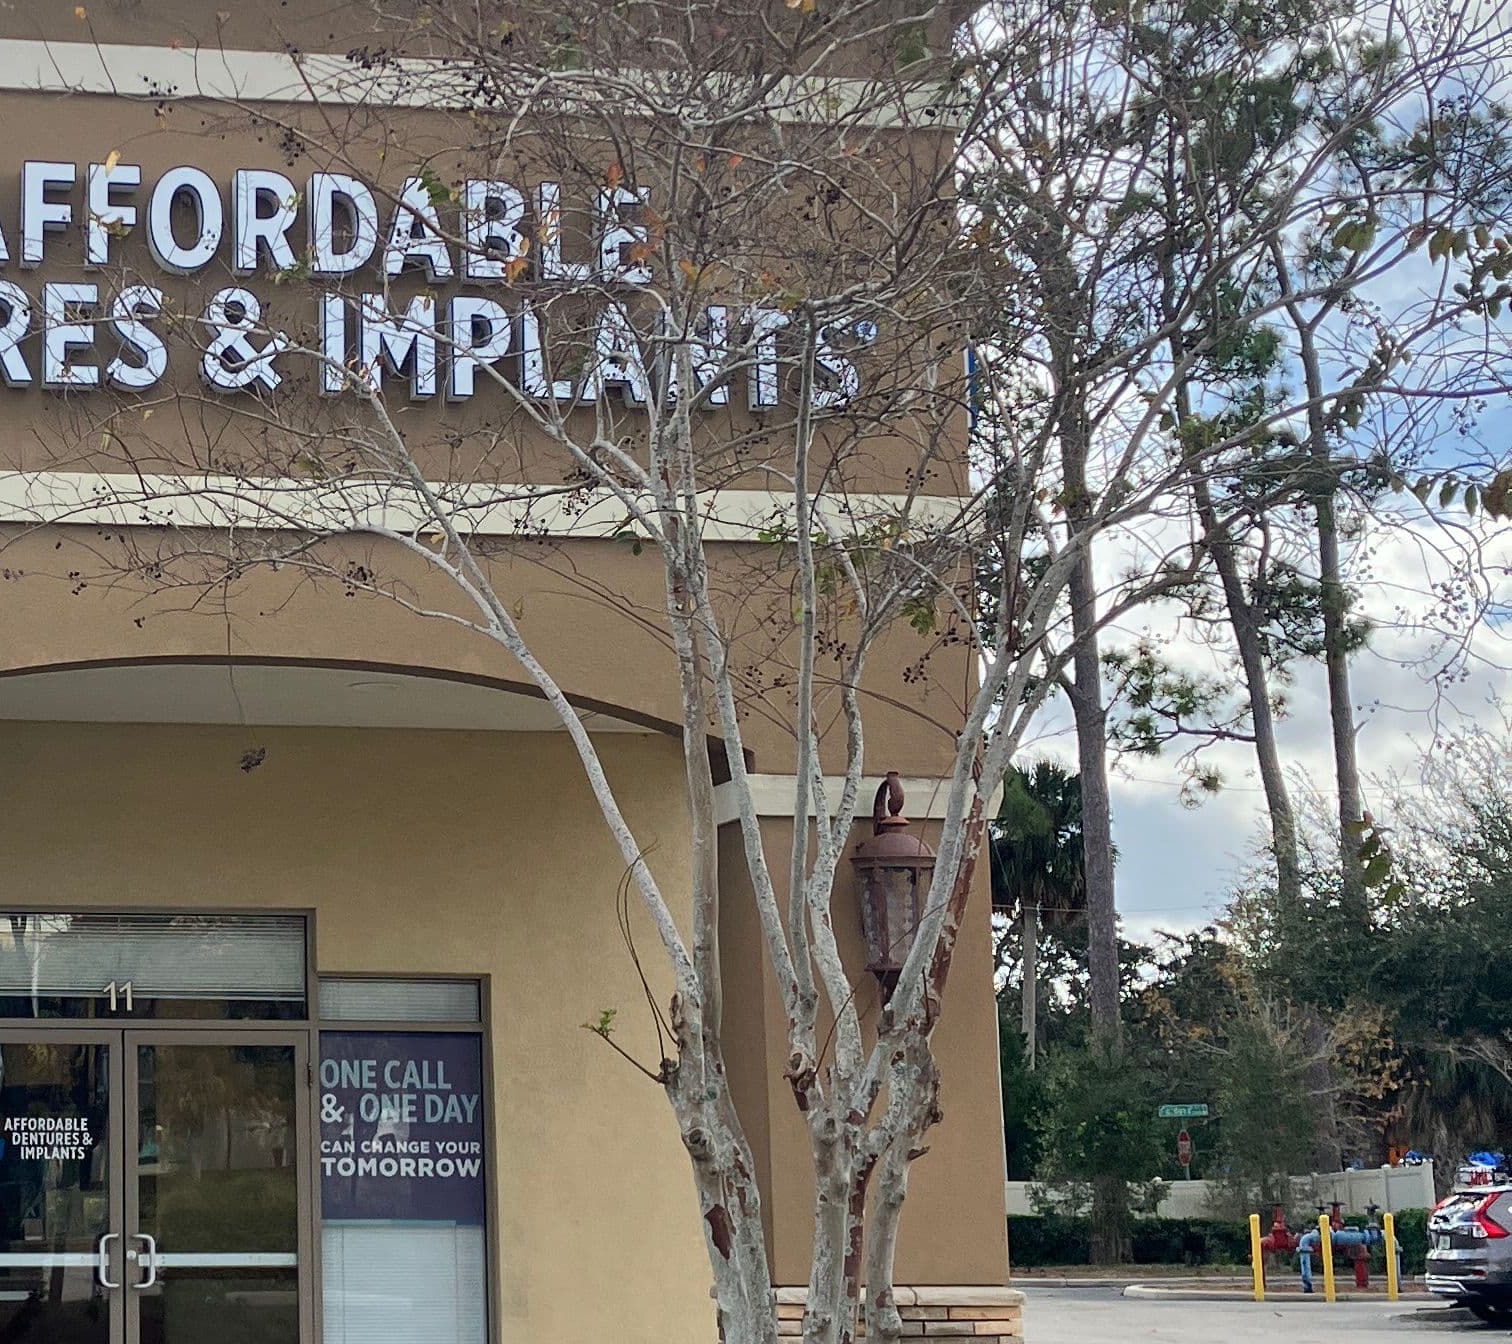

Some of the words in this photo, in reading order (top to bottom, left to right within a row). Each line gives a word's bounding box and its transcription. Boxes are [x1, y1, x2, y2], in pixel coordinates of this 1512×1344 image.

[200, 286, 289, 394] &
[320, 292, 861, 412] IMPLANTS
[103, 981, 133, 1011] 11
[320, 1059, 377, 1089] ONE
[384, 1060, 452, 1089] CALL
[320, 1093, 345, 1123] &
[359, 1093, 417, 1123] ONE
[424, 1094, 478, 1123] DAY
[4, 1117, 89, 1132] AFFORDABLE
[12, 1132, 80, 1146] DENTURES
[82, 1132, 94, 1145] &
[320, 1141, 355, 1154] CAN
[361, 1141, 430, 1154] CHANGE
[435, 1141, 481, 1154] YOUR
[20, 1146, 86, 1160] IMPLANTS
[321, 1158, 481, 1178] TOMORROW
